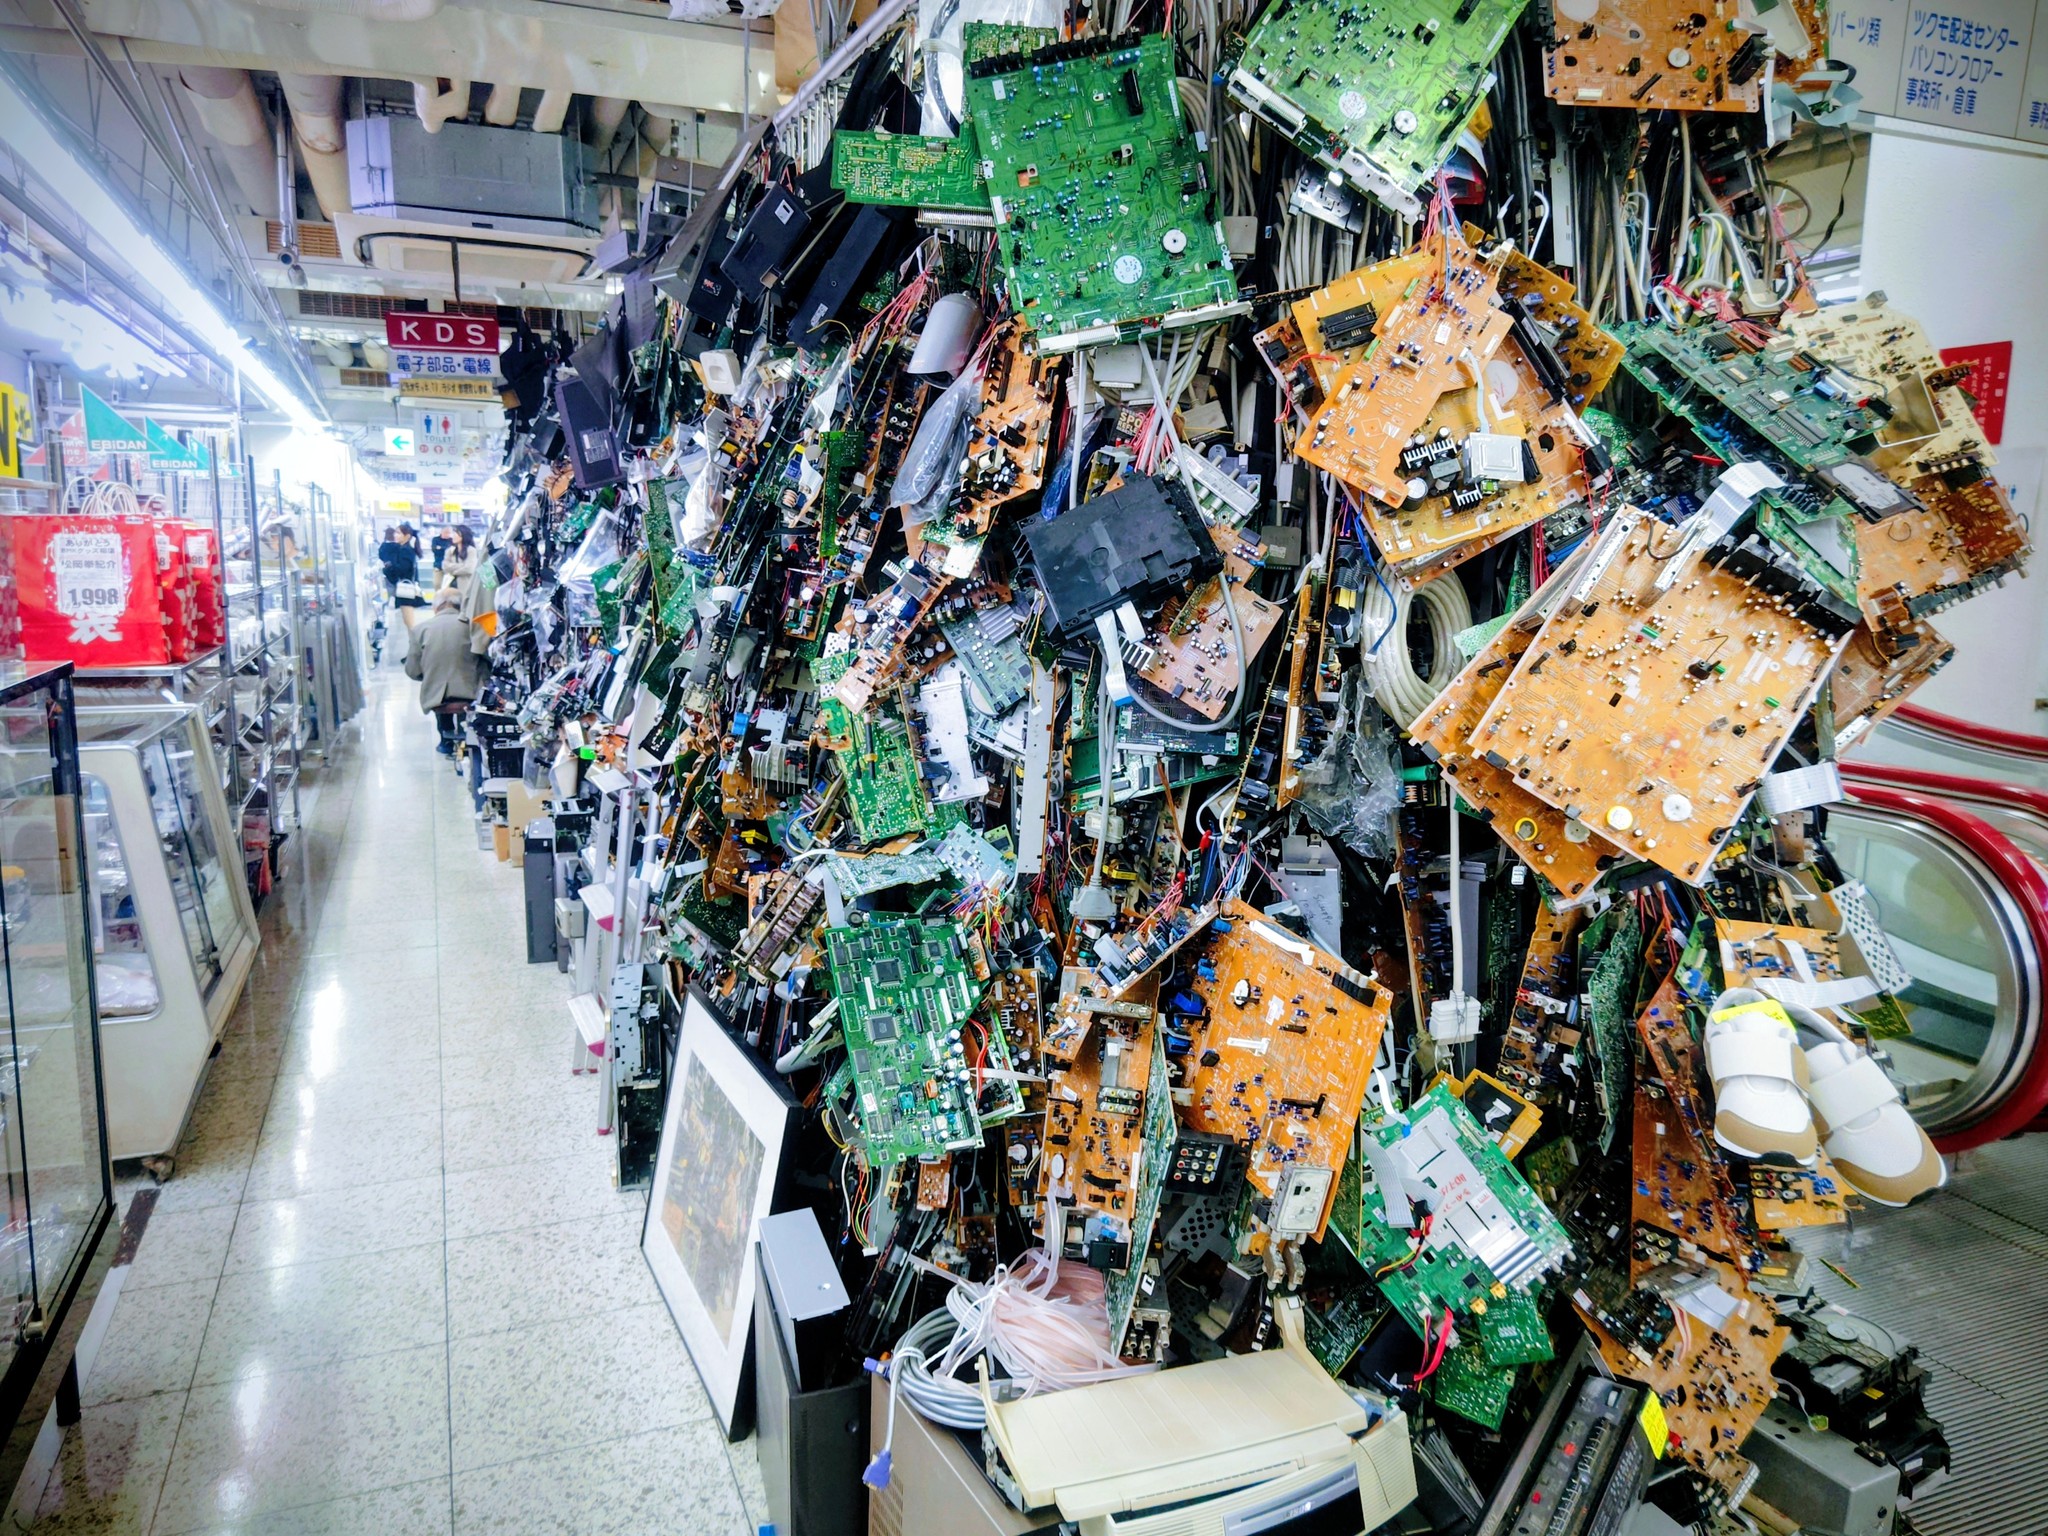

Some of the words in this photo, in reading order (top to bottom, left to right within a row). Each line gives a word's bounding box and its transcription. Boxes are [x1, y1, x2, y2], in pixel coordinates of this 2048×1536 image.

[1831, 10, 1883, 48] パーツ類
[1913, 9, 2019, 54] ツクモ配送センター
[1908, 43, 2004, 84] パソコンフロアー
[1905, 77, 1978, 116] 事務所・倉庫
[401, 321, 486, 345] KDS
[396, 354, 492, 375] 電子部品・電線
[1117, 420, 1139, 434] REFLE
[1119, 412, 1143, 428] SPO
[424, 435, 452, 443] TOILET
[68, 588, 118, 606] 1,998
